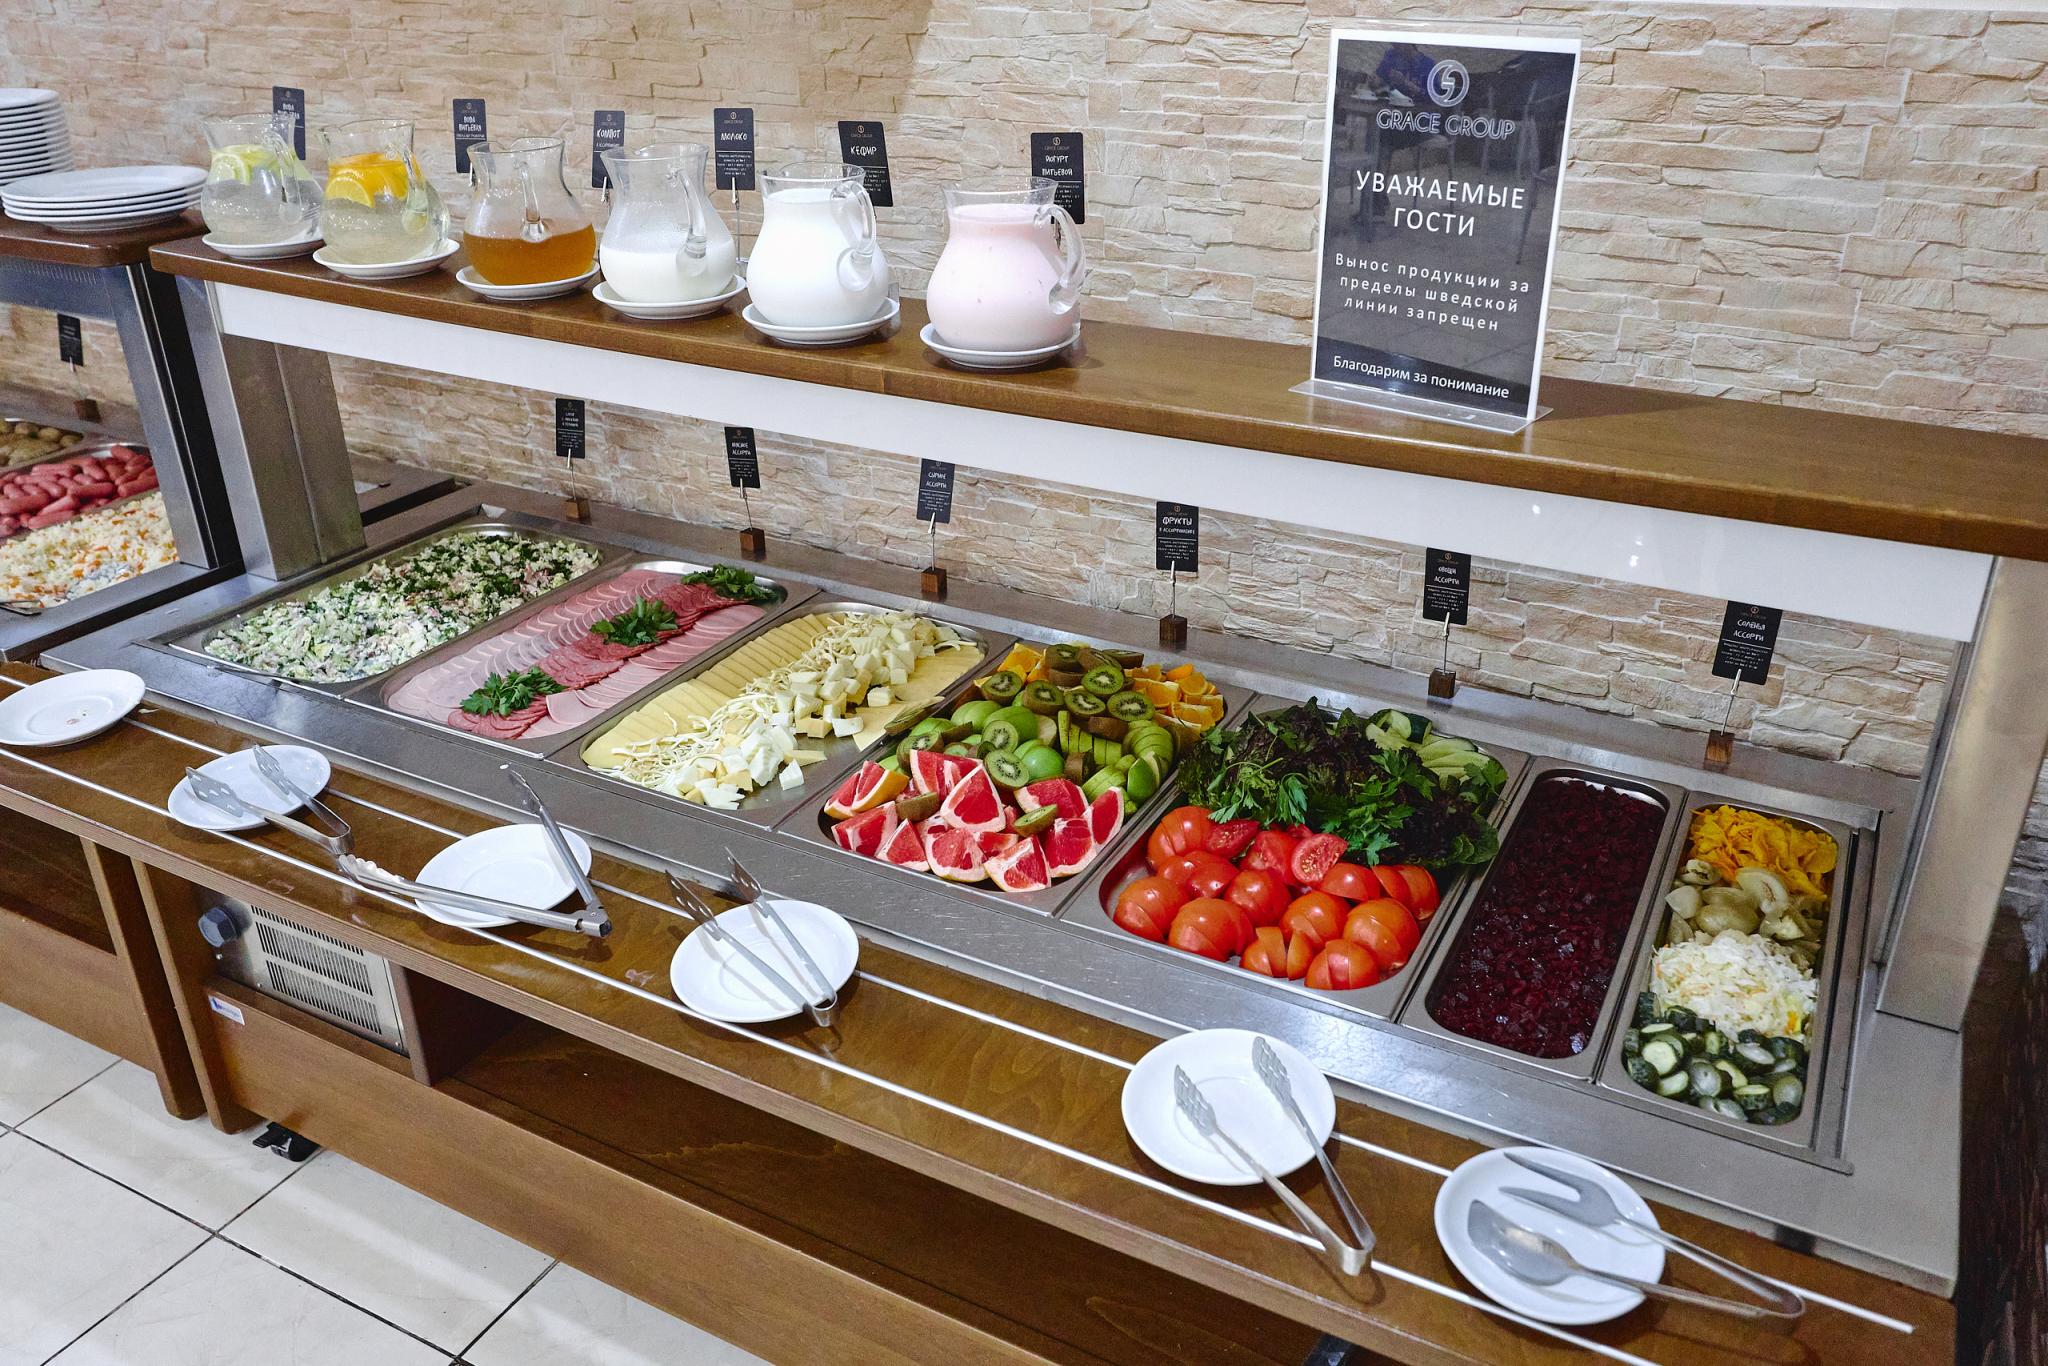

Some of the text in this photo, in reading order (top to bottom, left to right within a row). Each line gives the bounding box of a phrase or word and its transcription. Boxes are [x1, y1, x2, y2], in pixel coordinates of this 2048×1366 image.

[1376, 108, 1516, 141] GRACE GROUP
[596, 128, 621, 140] КОМПОТ
[720, 131, 748, 141] МОЛОКО
[850, 145, 877, 157] КЕФИР
[1045, 154, 1069, 164] ЙОГУРТ
[1041, 168, 1073, 177] ПИТЬЕВОЙ
[1356, 169, 1526, 210] УВАЖАЕМЫЕ
[1393, 207, 1476, 237] ГОСТИ
[1335, 252, 1530, 293] Вынос продукции за
[1340, 276, 1518, 313] пределы шведской
[1344, 297, 1499, 332] линии запрещен
[1333, 355, 1510, 399] Благодарим за понимание
[1162, 516, 1193, 526] ФРУКТЫ
[1433, 575, 1460, 585] АССОРТИ
[1733, 629, 1765, 642] АССОРТИ
